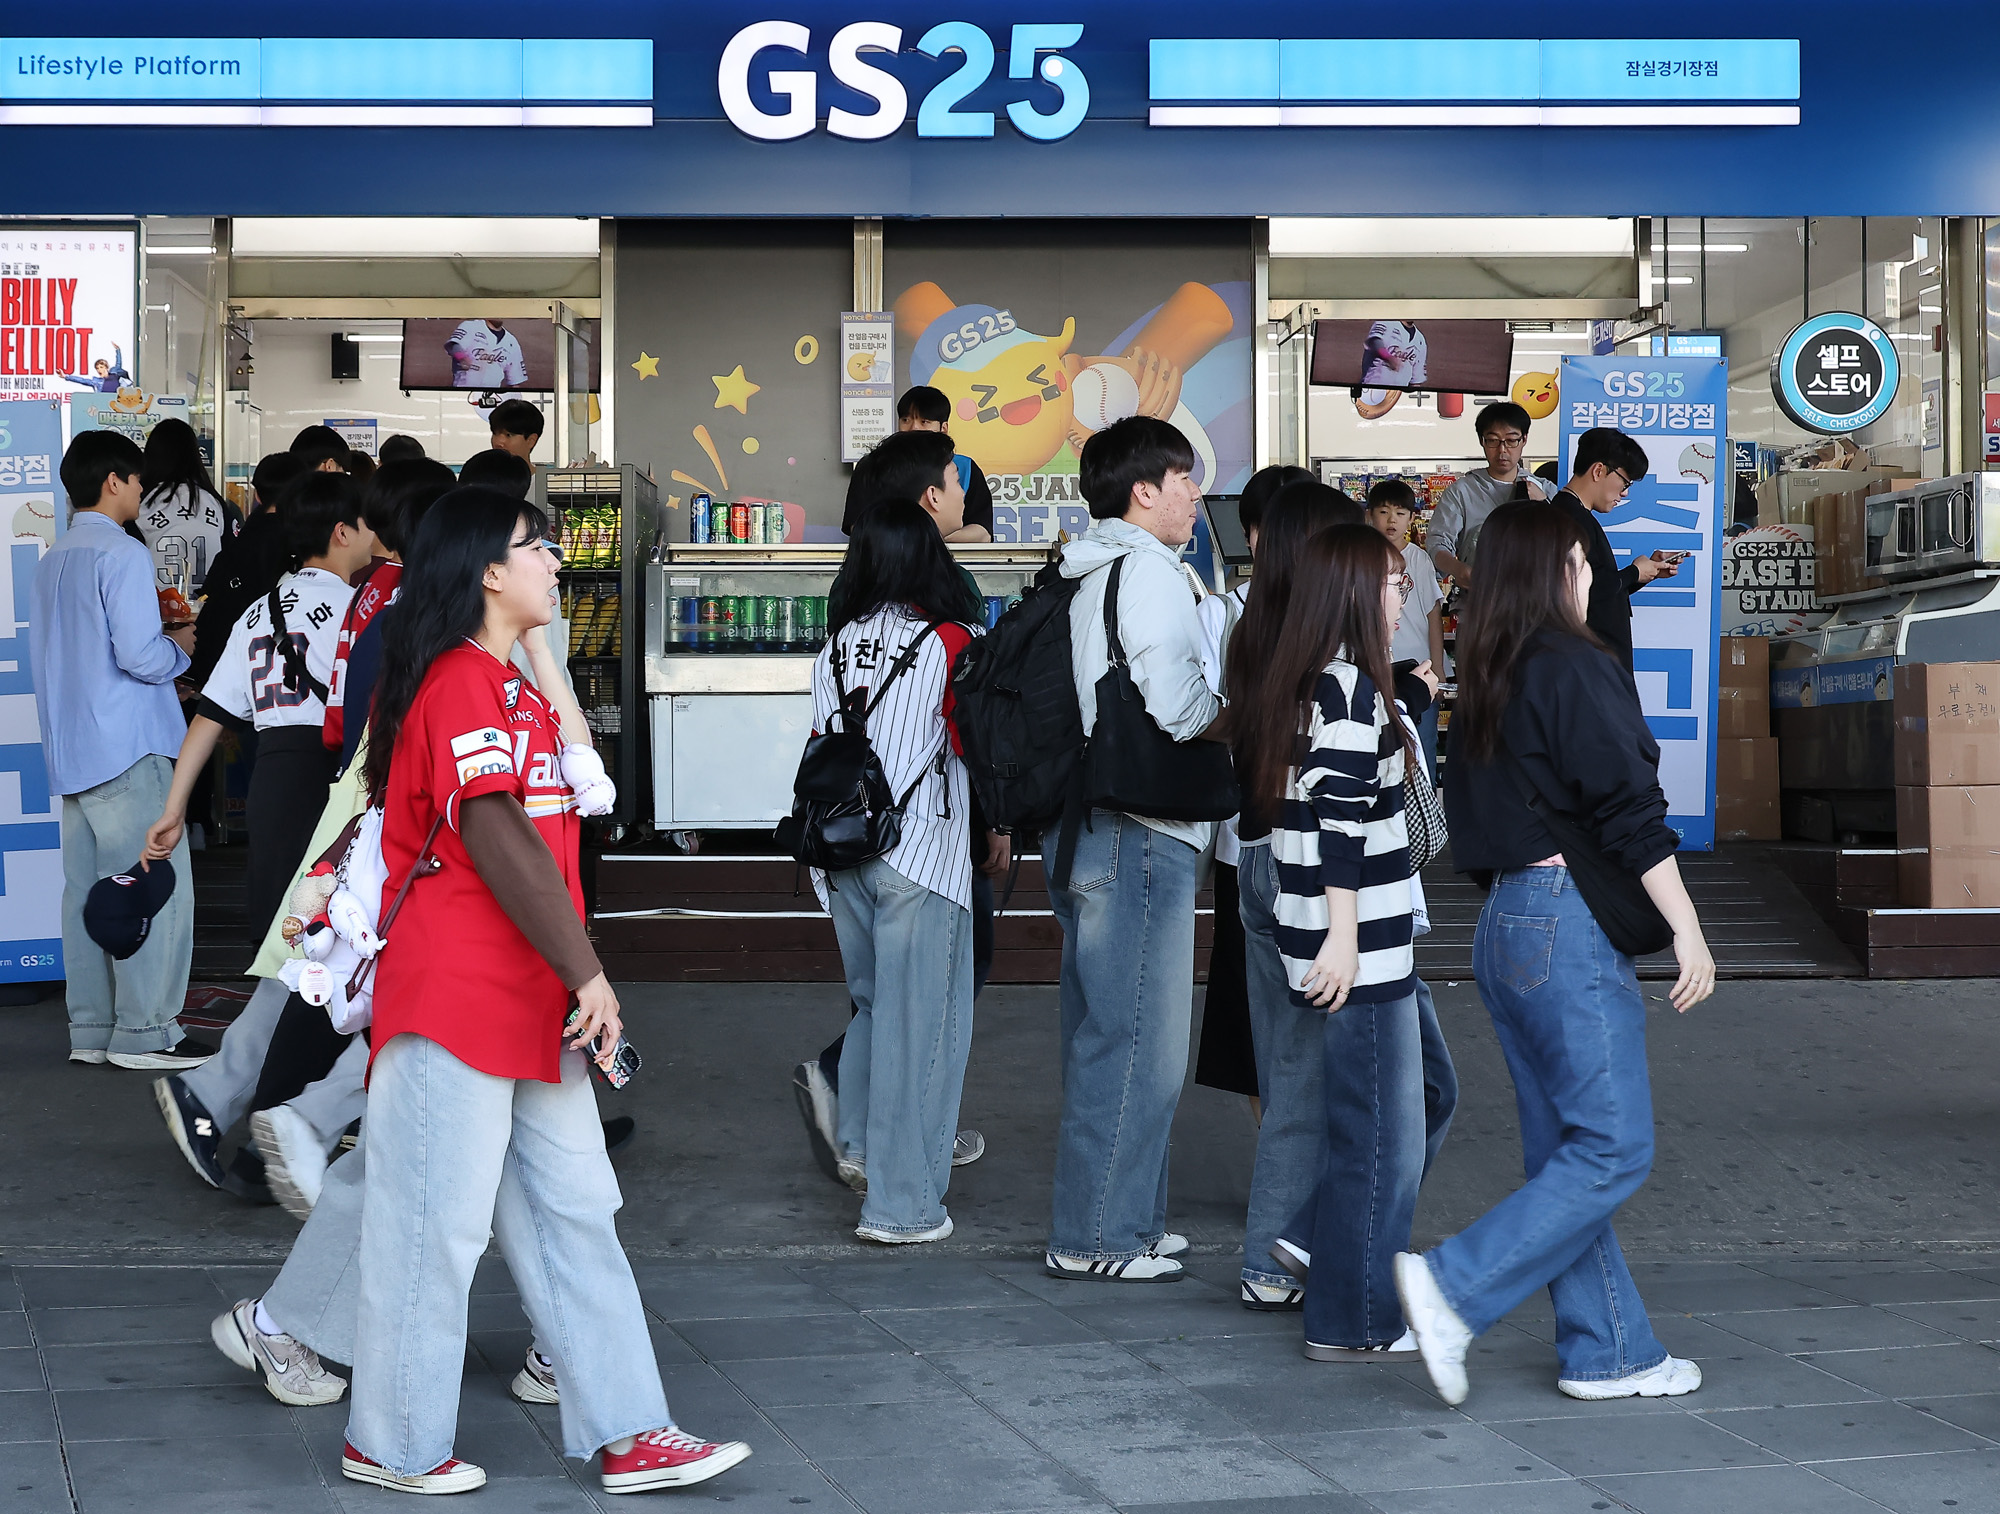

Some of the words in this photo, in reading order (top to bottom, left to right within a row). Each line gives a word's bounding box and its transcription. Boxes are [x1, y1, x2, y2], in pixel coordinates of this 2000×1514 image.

[18, 55, 123, 80] Lifestyle
[134, 55, 241, 76] Platform
[717, 20, 1090, 140] GS25
[1625, 59, 1719, 78] 잠실경기장점
[1, 278, 78, 326] BILLY
[938, 309, 1017, 363] GS25
[1, 328, 93, 375] ELLIOT
[1817, 344, 1861, 370] 셀프
[1, 378, 12, 390] THE
[14, 377, 45, 390] MUSICAL
[1603, 371, 1685, 398] GS25
[1807, 373, 1871, 398] 스토어
[1572, 402, 1716, 430] 잠실경기장점
[1802, 407, 1823, 424] SELF
[1830, 406, 1879, 428] CHECKOUT
[156, 536, 207, 584] 31
[1735, 543, 1779, 557] GS25
[1721, 559, 1796, 586] BASE
[1742, 590, 1833, 610] STADIU
[20, 953, 55, 967] GS25
[195, 1117, 212, 1137] N
